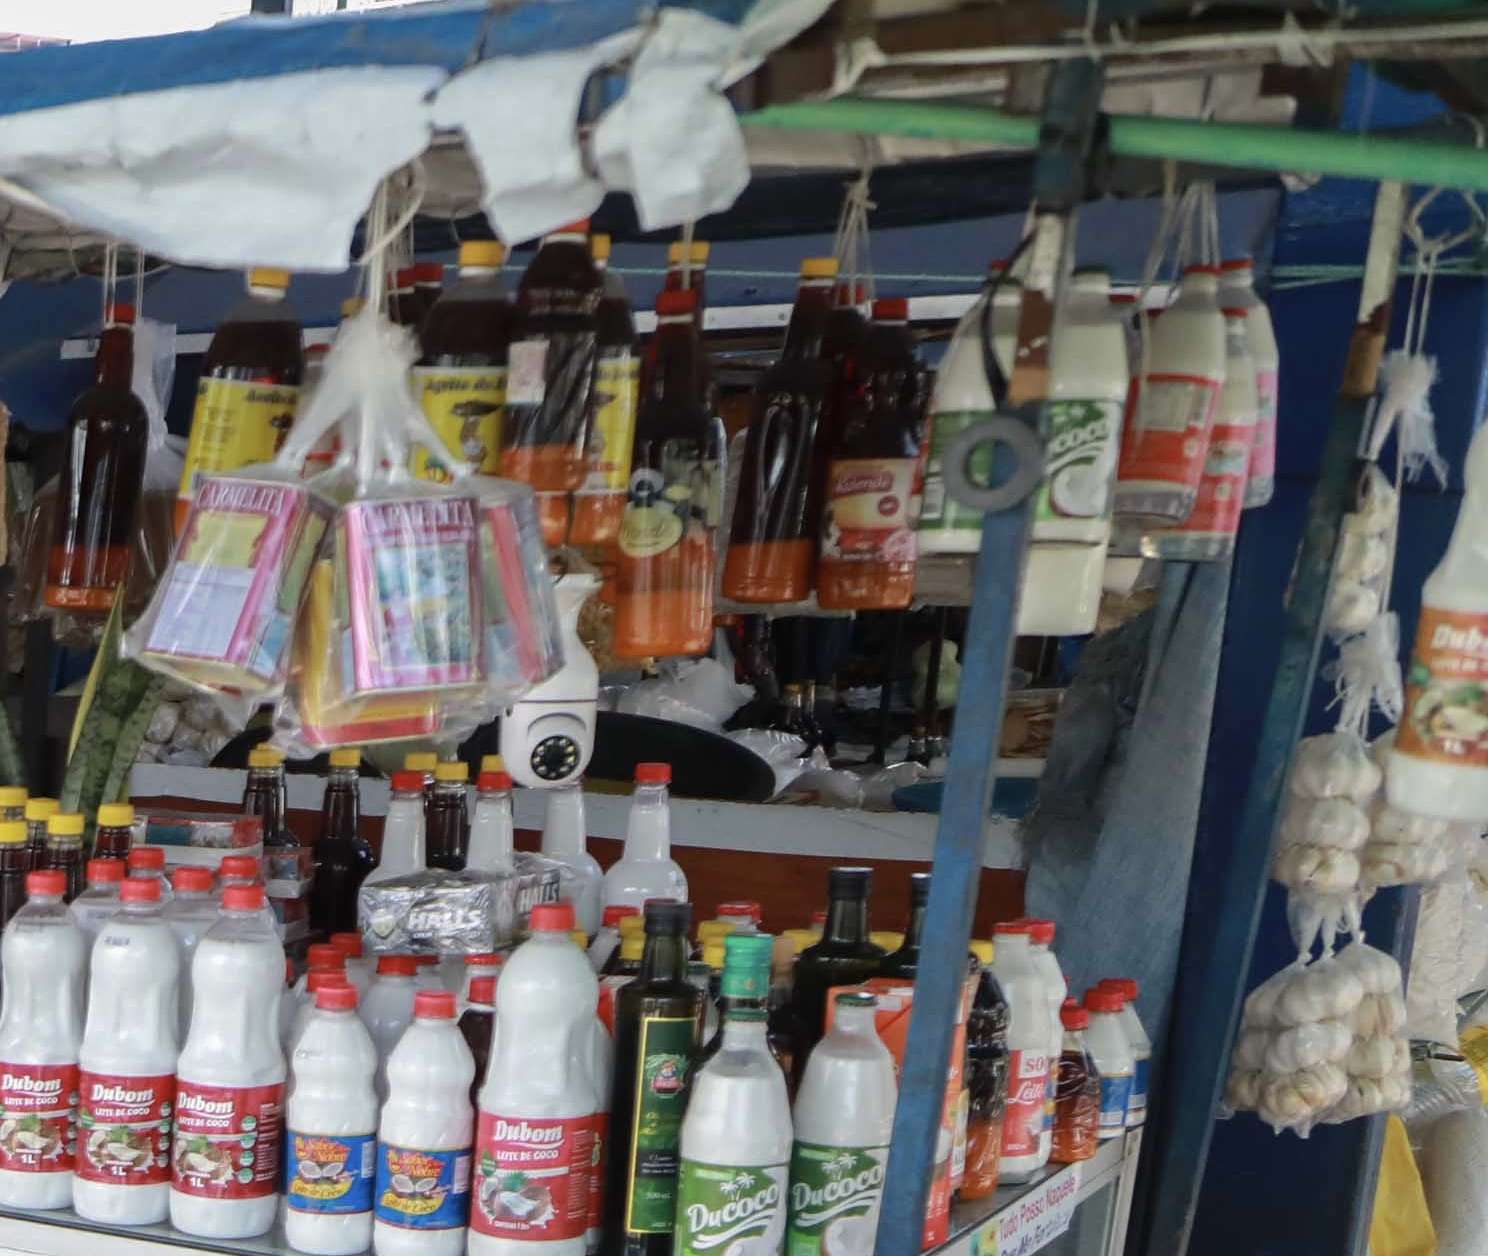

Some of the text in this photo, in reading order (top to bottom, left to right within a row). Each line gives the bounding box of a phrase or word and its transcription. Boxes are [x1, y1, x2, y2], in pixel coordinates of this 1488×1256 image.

[198, 483, 285, 515] CARMELITA
[408, 908, 483, 932] HALLS
[1, 1073, 62, 1092] Dubom
[35, 1096, 59, 1105] COCO
[91, 1084, 154, 1103] Dubom
[178, 1092, 234, 1115] Dubom
[127, 1106, 150, 1116] COCO
[206, 1117, 230, 1128] COCO
[493, 1120, 564, 1142] Dubom
[495, 1149, 559, 1161] LEITE DE COCO
[791, 1165, 883, 1211] Ducoco
[687, 1184, 779, 1233] Ducoco
